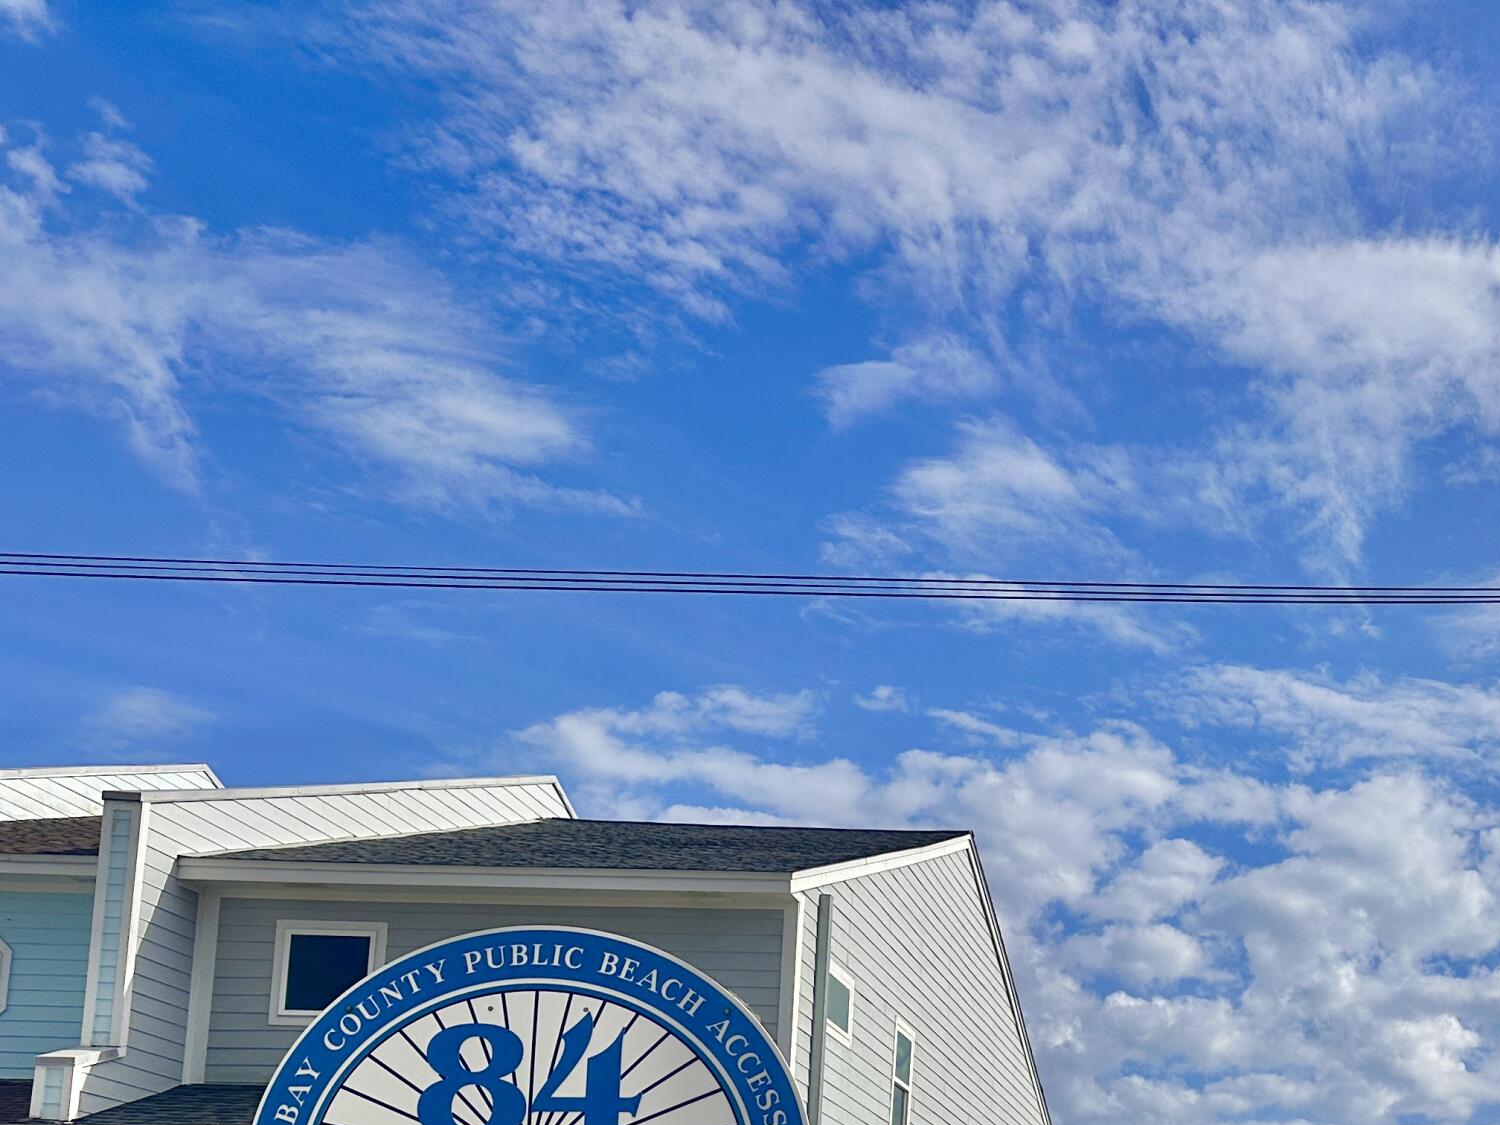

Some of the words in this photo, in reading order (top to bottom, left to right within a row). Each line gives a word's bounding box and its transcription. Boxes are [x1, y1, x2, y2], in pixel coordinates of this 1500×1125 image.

[323, 959, 447, 1051] COUNTY
[463, 943, 584, 974] PUBLIC
[598, 951, 707, 1018] BEACH
